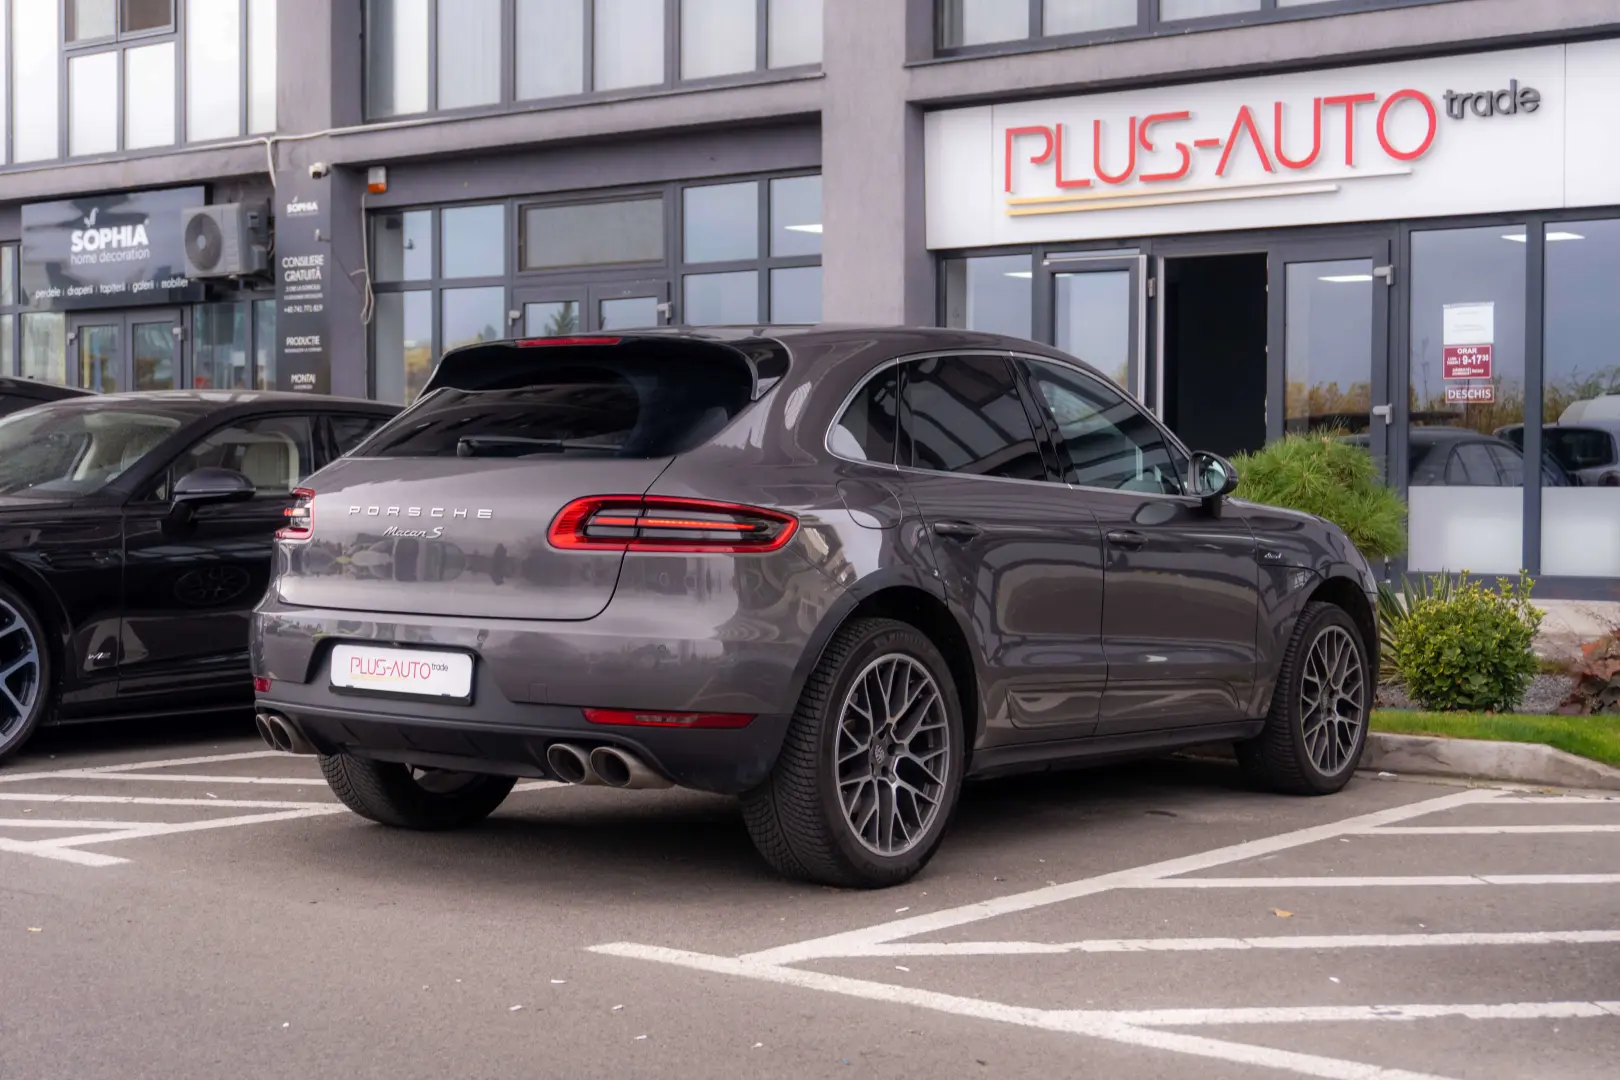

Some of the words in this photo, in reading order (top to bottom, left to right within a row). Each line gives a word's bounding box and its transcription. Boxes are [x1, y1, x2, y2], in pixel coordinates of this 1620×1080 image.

[1004, 88, 1437, 193] PLUS-AUTO
[1443, 79, 1541, 120] trade
[71, 224, 149, 252] SOPHIA
[70, 253, 97, 266] home
[99, 248, 150, 264] decoration
[35, 287, 61, 299] perdele
[1447, 388, 1492, 400] DESCHIS
[348, 505, 493, 519] PORSCHE
[382, 526, 427, 538] Macan
[426, 526, 444, 539] S
[350, 656, 431, 680] PLUS-AUTO
[431, 662, 449, 672] trade
